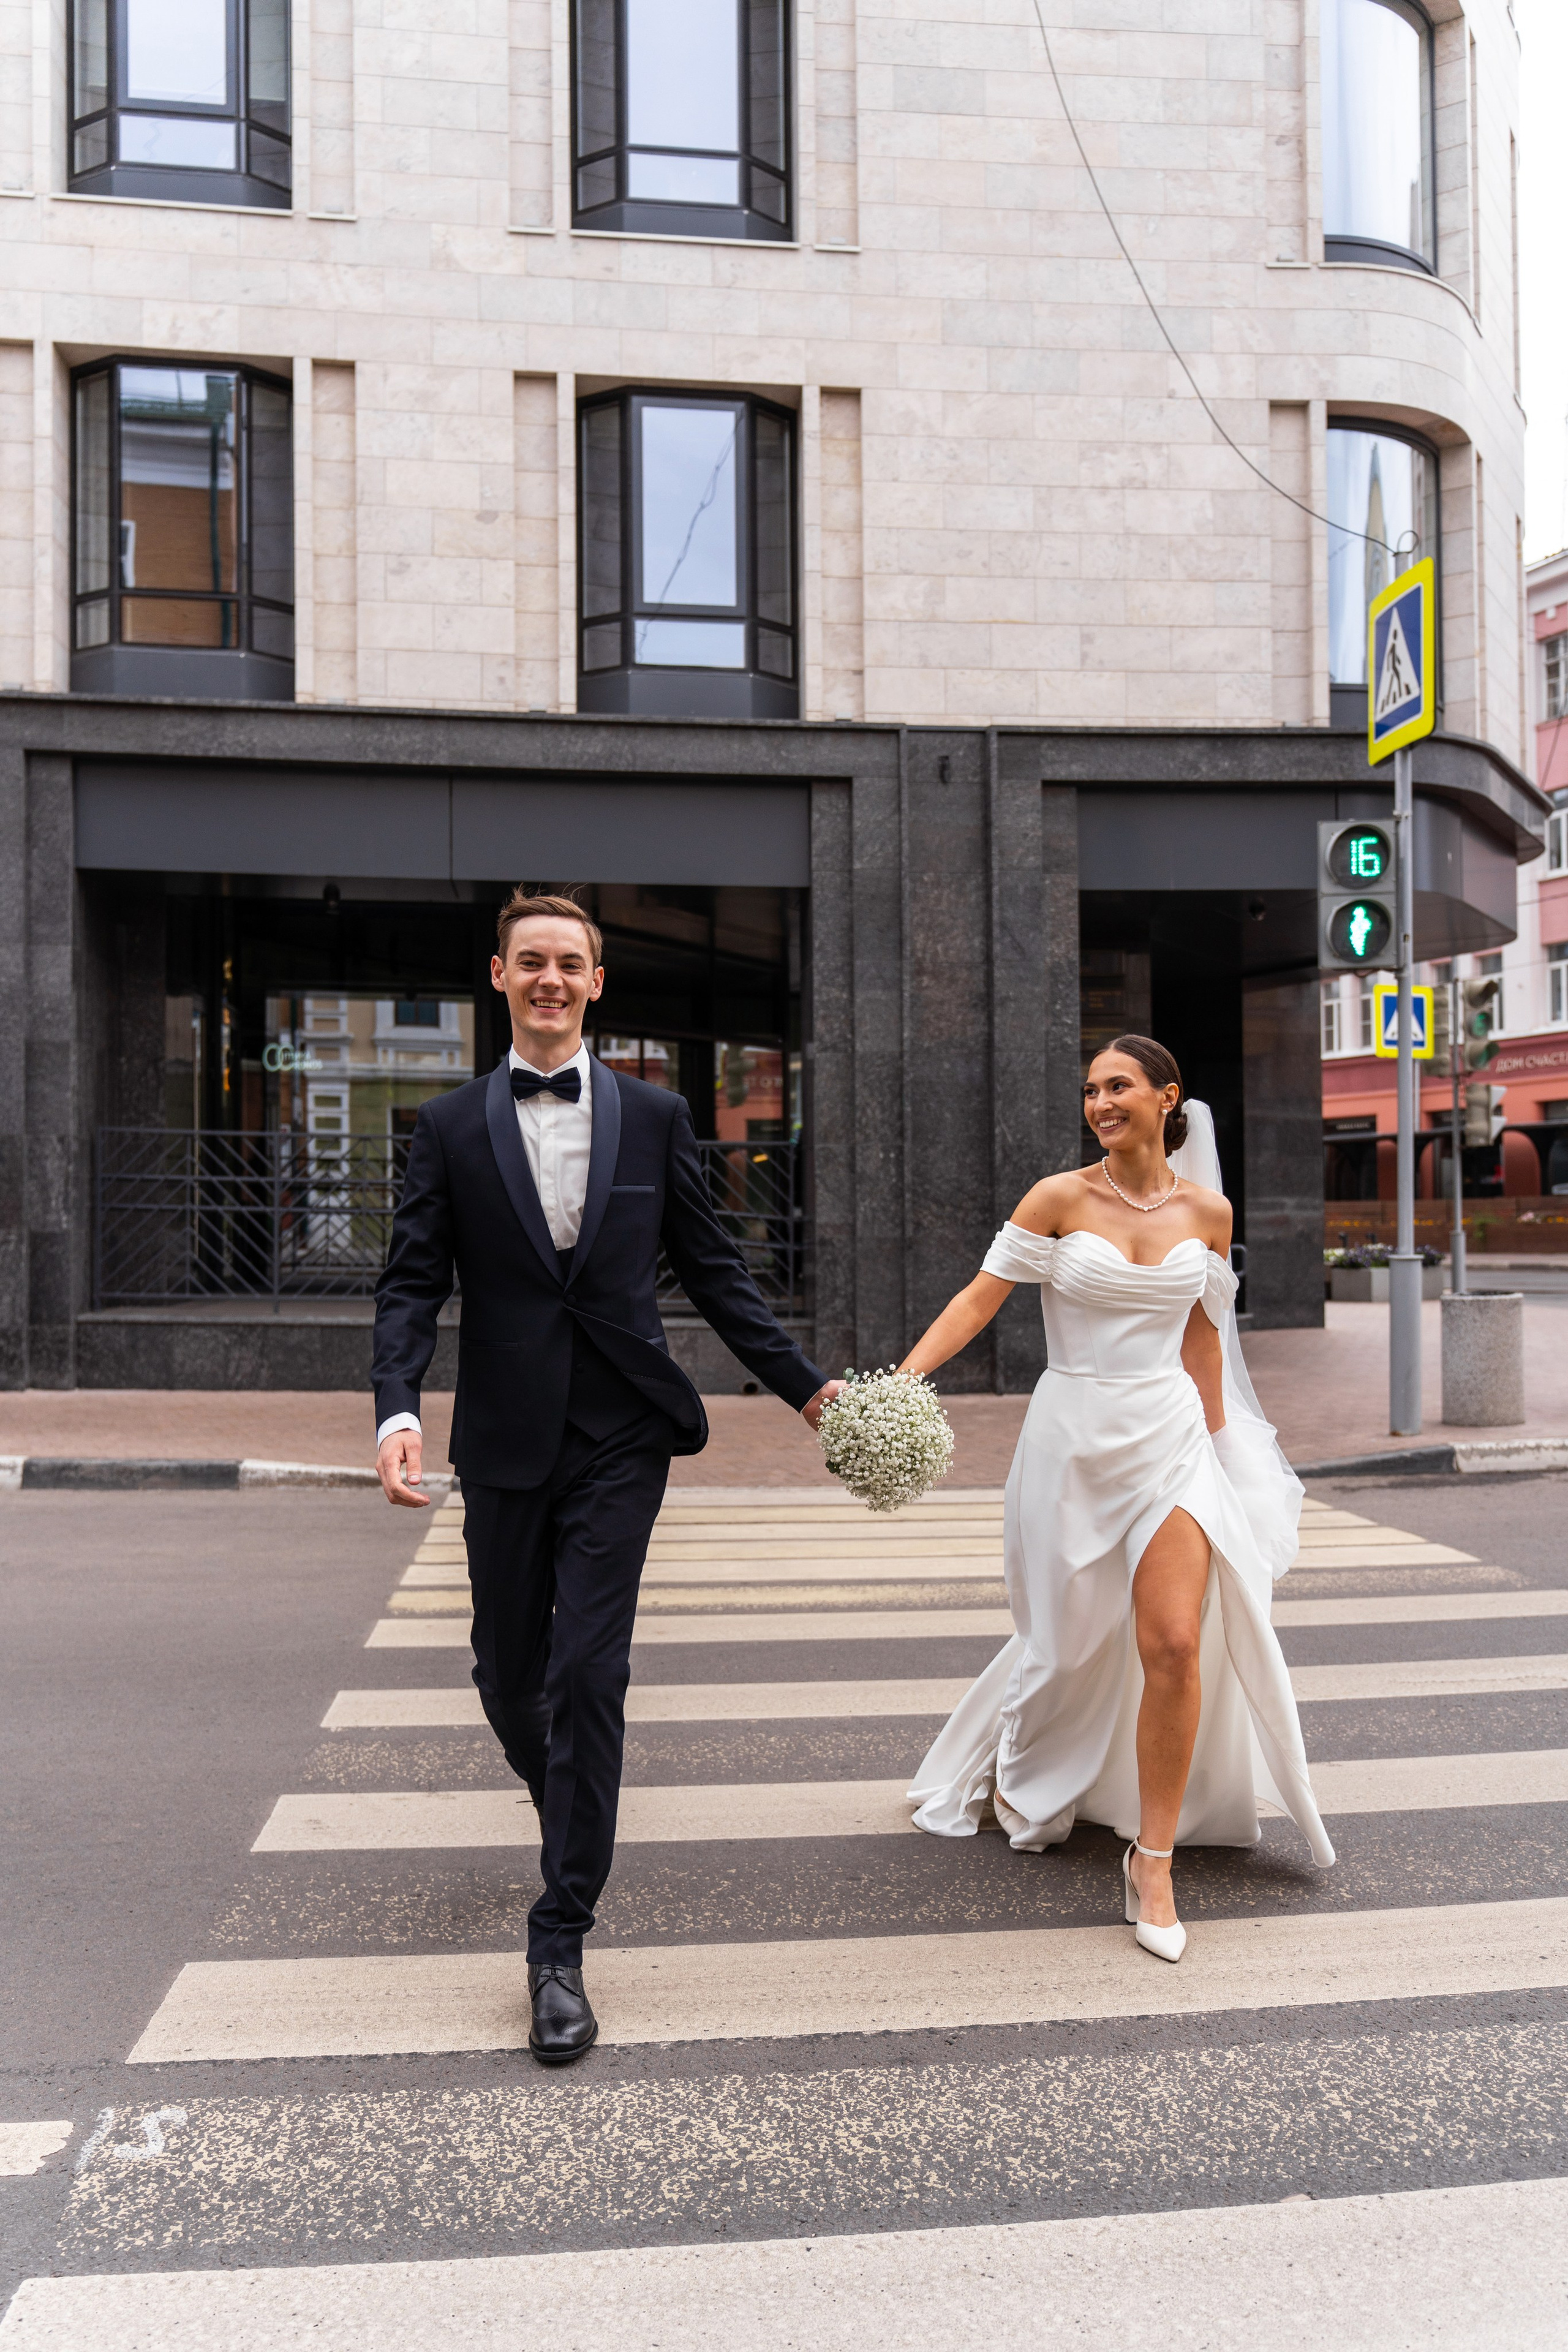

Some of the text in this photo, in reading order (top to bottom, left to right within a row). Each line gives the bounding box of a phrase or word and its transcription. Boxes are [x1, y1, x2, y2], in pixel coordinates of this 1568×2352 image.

[1351, 837, 1380, 876] 16
[1496, 1051, 1568, 1073] ДОМ СЧАСТ
